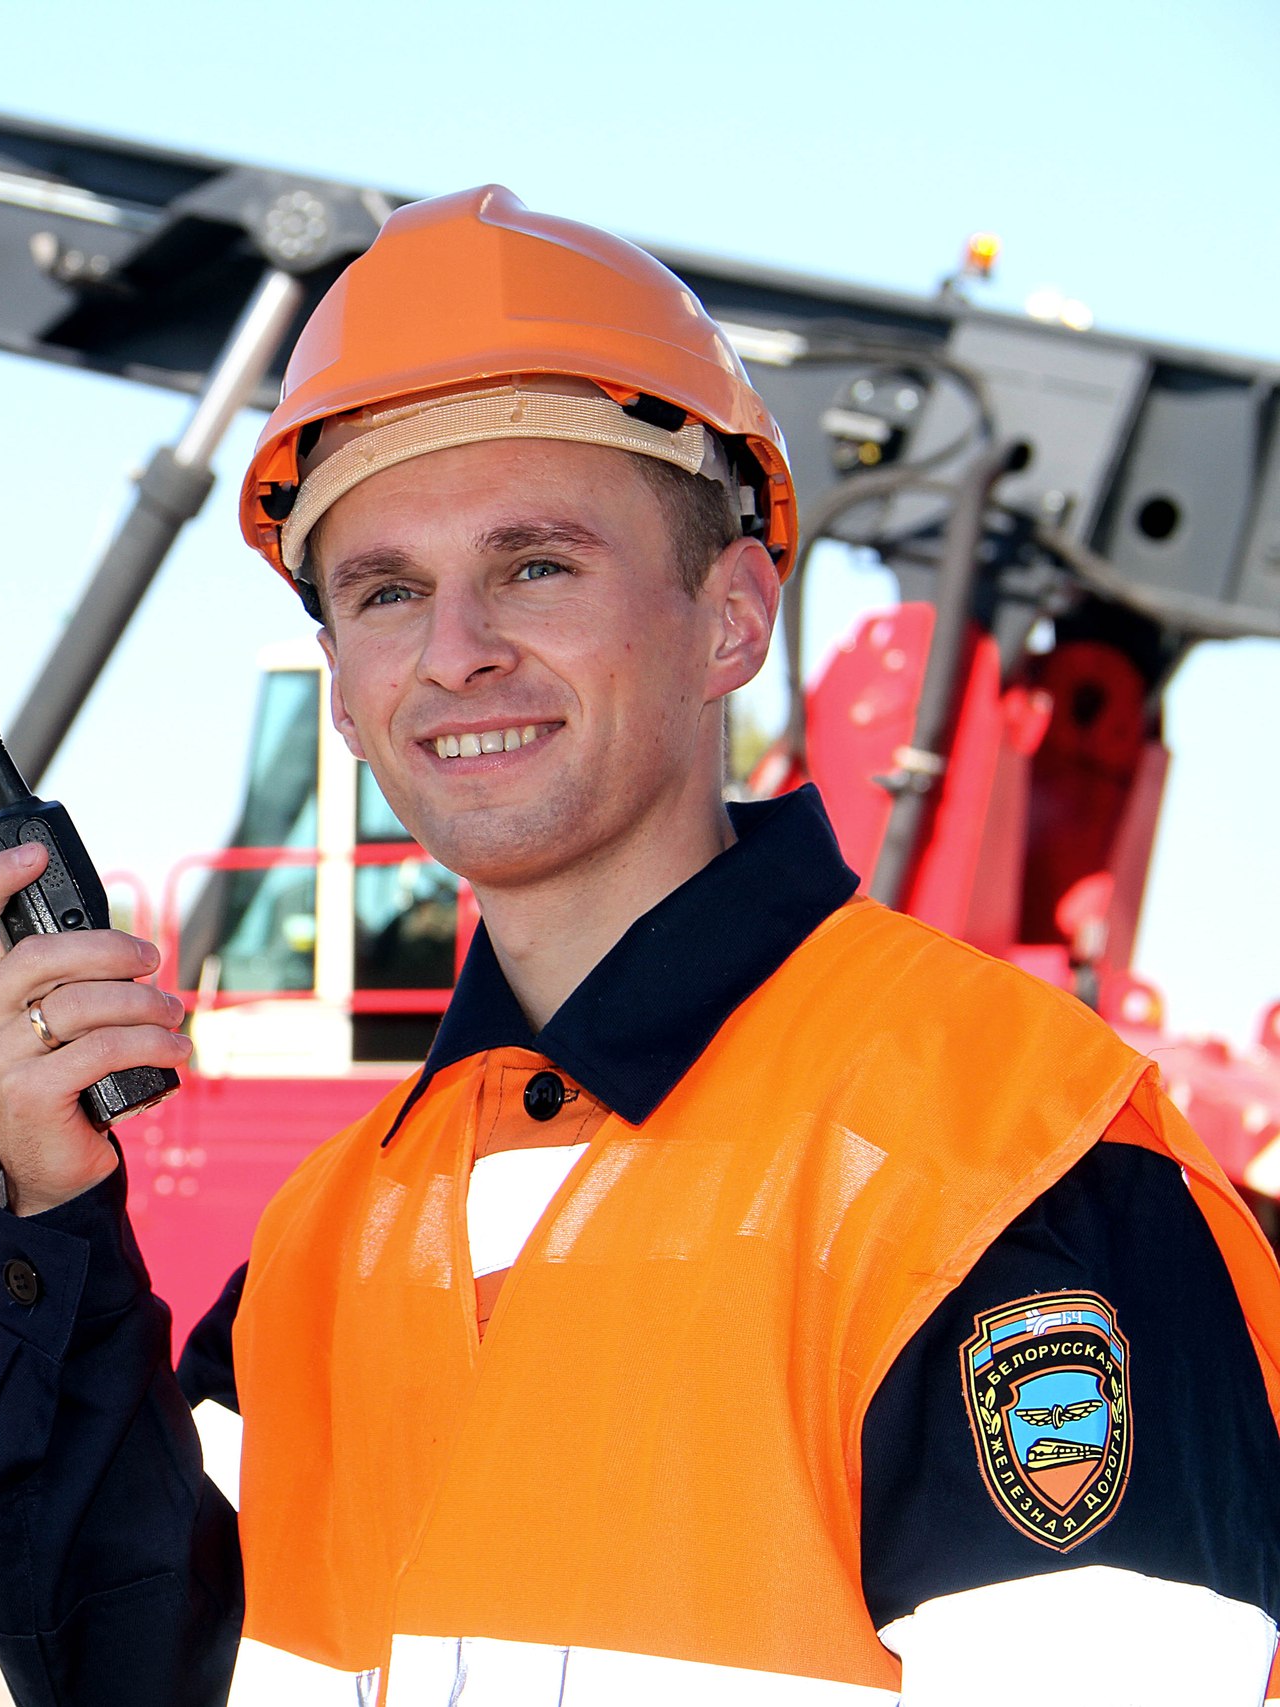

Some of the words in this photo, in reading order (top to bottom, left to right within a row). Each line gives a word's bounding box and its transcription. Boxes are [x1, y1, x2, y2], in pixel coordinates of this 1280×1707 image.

[1061, 1310, 1083, 1325] БЧ
[986, 1341, 1114, 1386] БЕЛОРУССКАЯ
[990, 1436, 1077, 1533] ЖЕЛЕЗНАЯ
[1084, 1428, 1122, 1510] ДОРОГА
